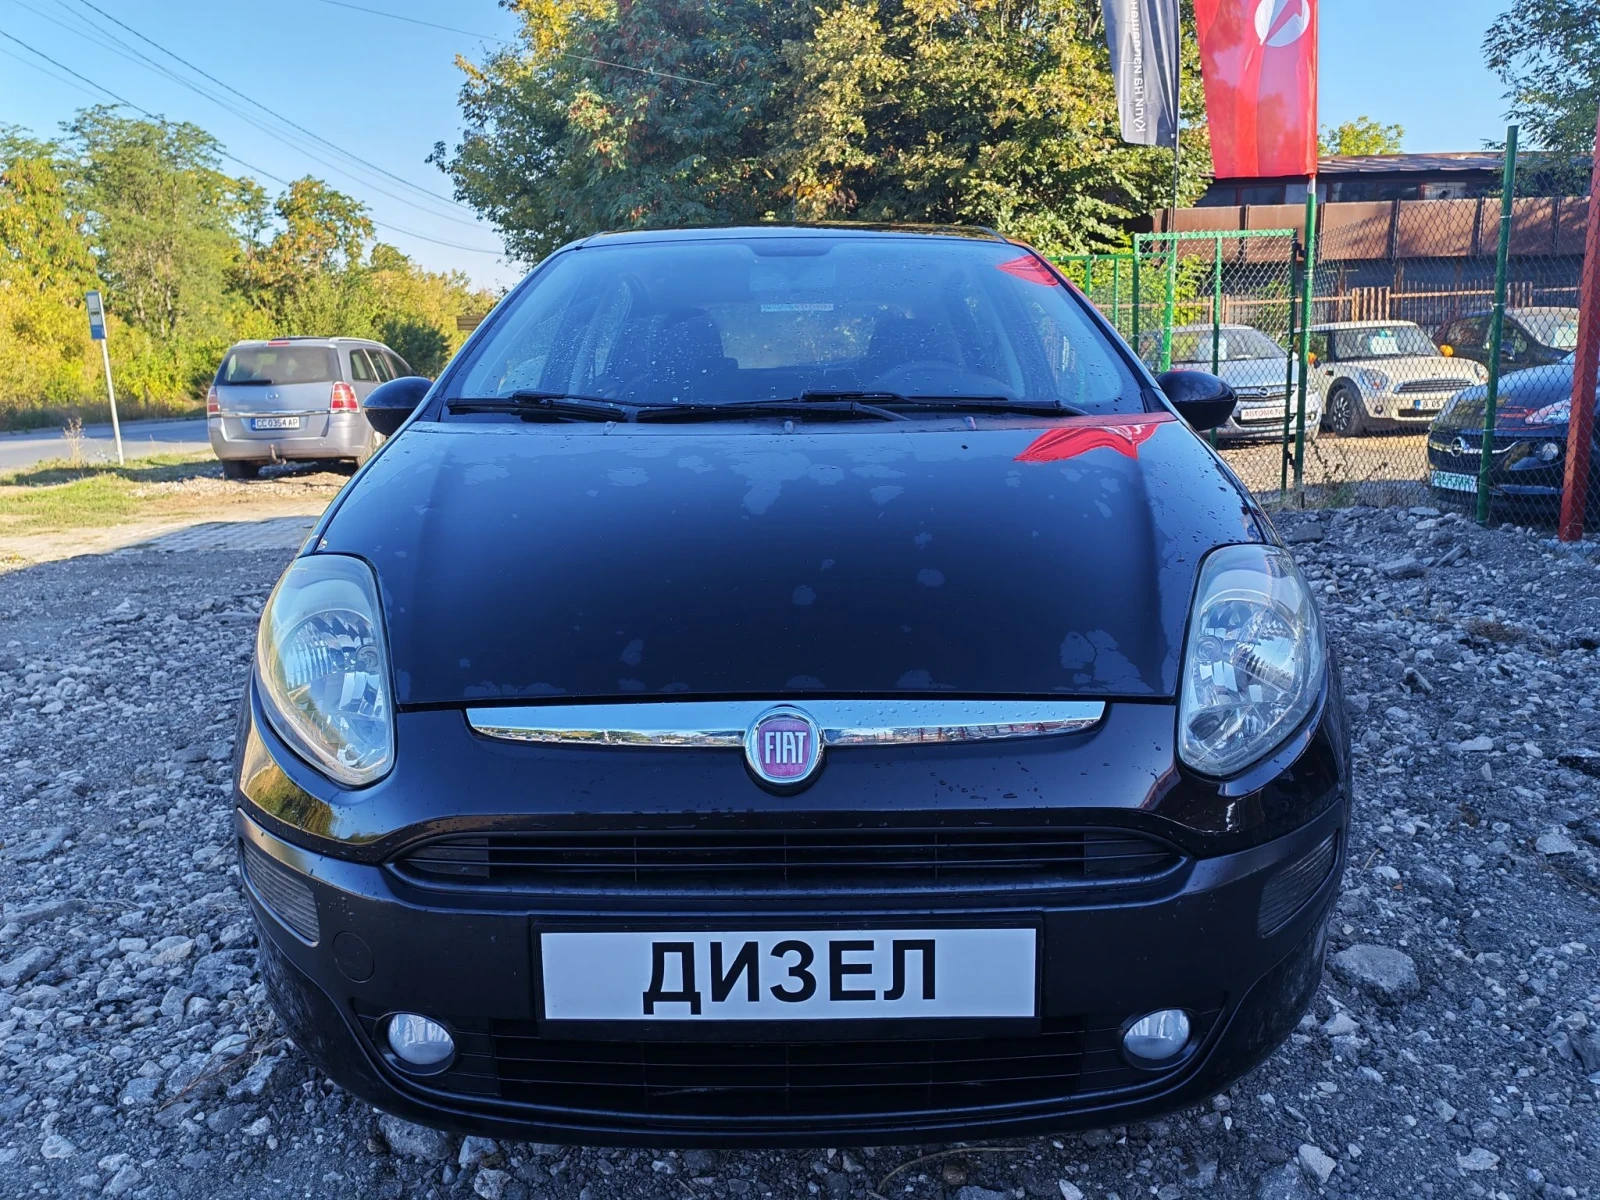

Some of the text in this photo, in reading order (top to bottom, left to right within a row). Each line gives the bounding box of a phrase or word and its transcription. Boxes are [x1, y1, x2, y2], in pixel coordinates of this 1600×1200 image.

[256, 418, 298, 428] CC 0354 AP
[1244, 408, 1286, 417] АВТОМАТИ
[764, 731, 807, 764] FIAT
[642, 939, 937, 1016] ДИЗЕЛ
